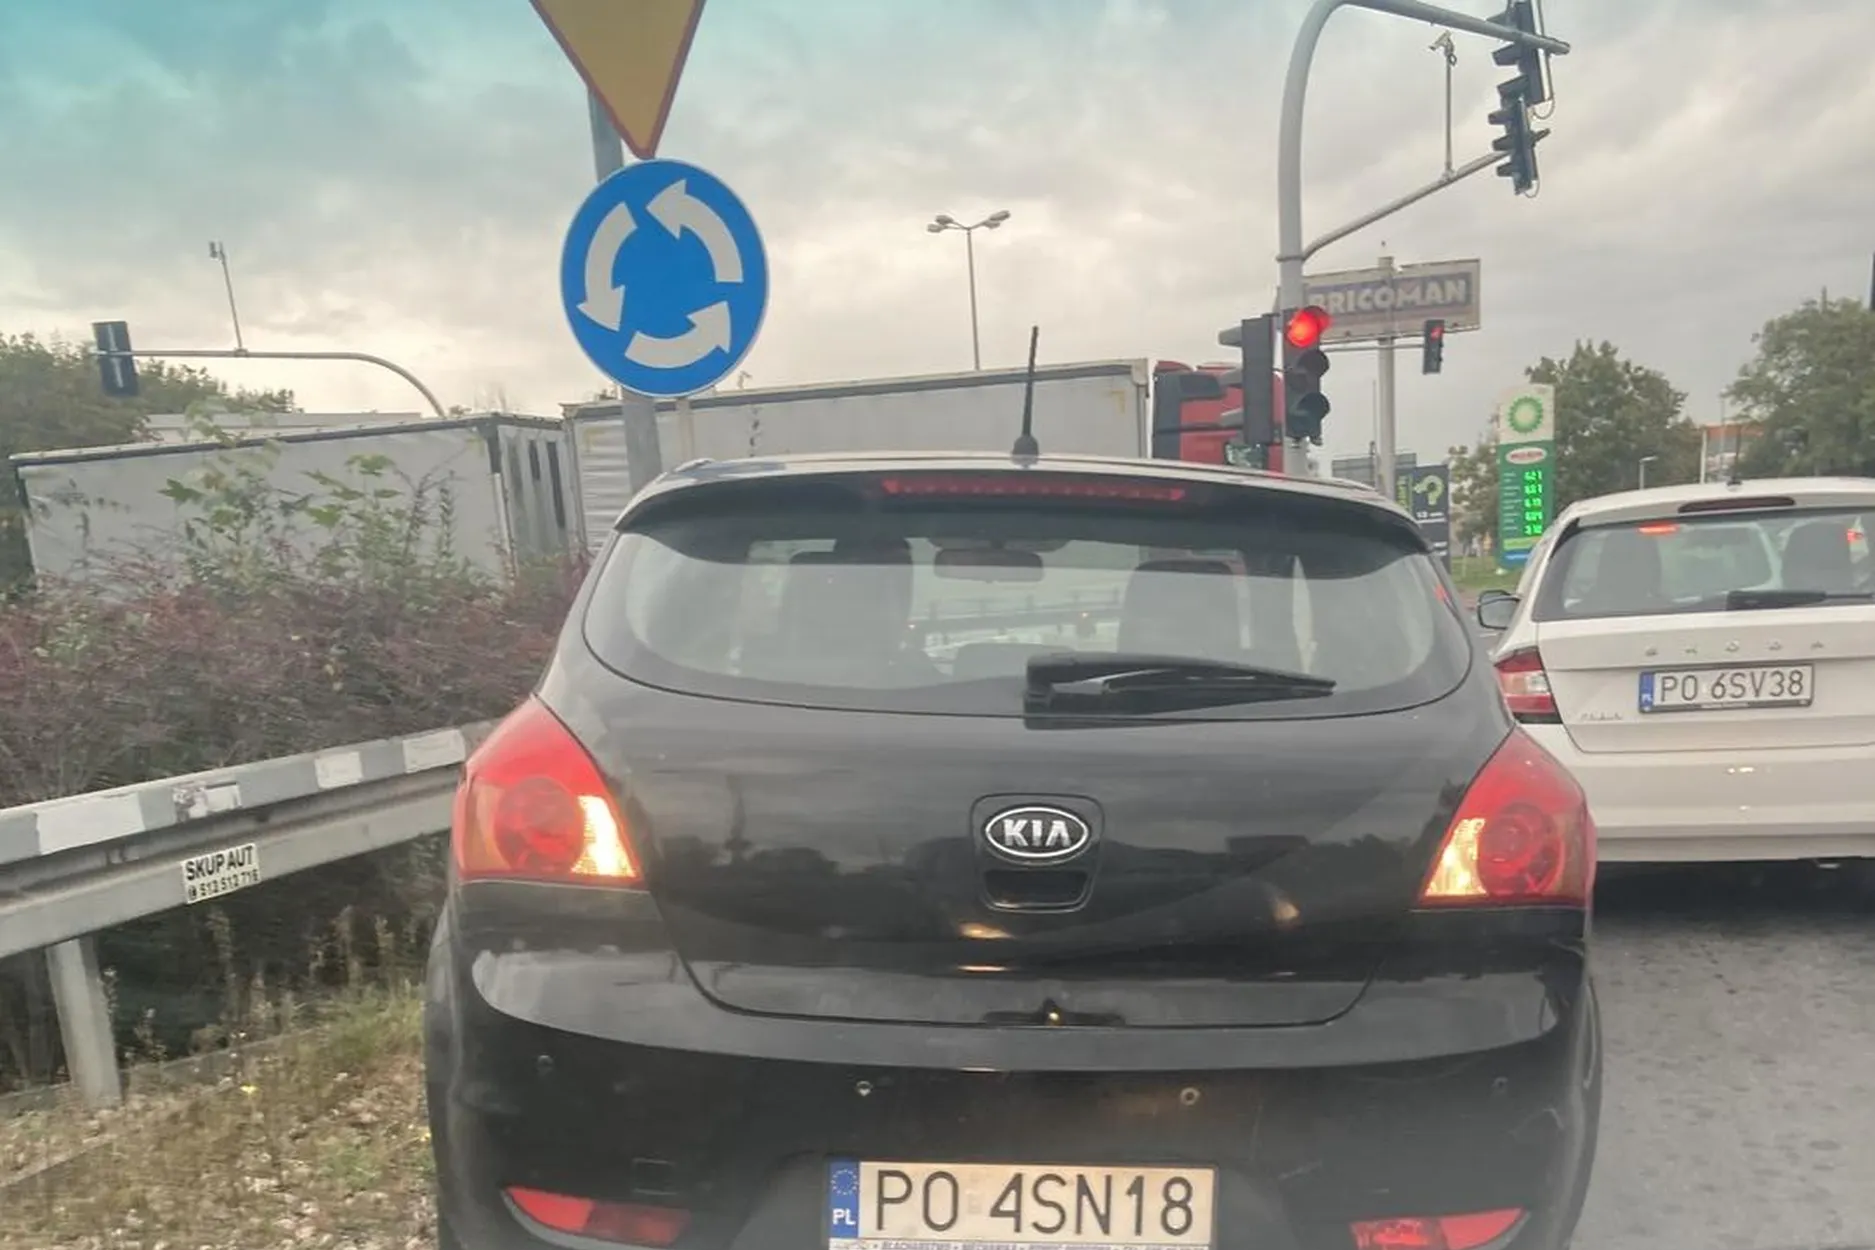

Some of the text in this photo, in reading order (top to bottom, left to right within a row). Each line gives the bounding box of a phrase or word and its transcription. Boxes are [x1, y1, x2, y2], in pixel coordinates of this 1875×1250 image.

[1660, 670, 1804, 702] PO 6SV38
[1003, 819, 1071, 847] KIA
[186, 846, 253, 881] SKUP AUT
[220, 873, 239, 891] 512
[832, 1208, 856, 1226] PL
[876, 1169, 1194, 1237] PO 4SN18
